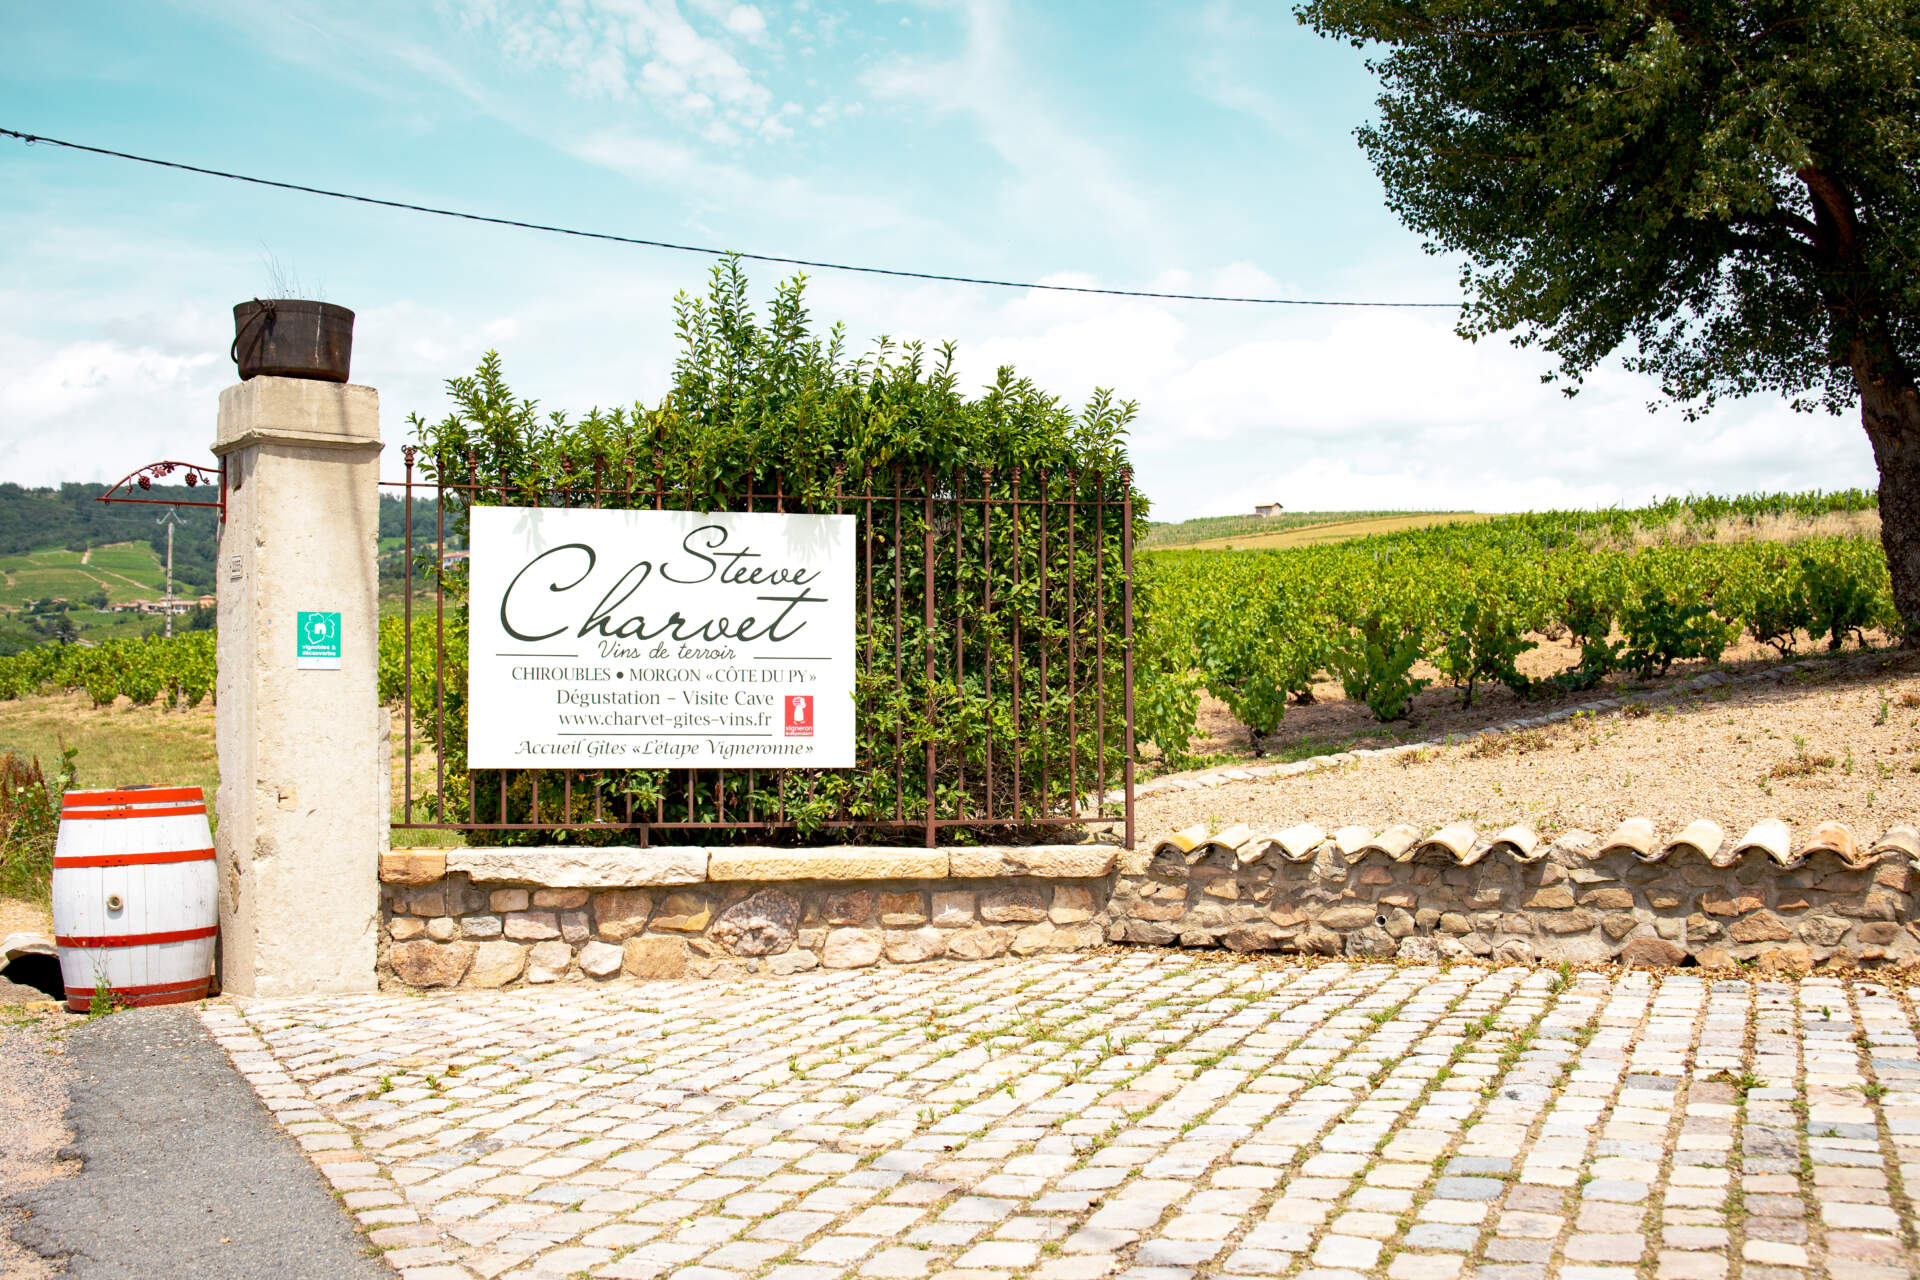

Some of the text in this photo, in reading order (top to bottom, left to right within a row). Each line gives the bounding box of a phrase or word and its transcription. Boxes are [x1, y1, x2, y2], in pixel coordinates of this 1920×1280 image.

[659, 524, 822, 585] Steeve
[499, 542, 829, 643] Charvet
[597, 640, 736, 660] Vins de terroir
[511, 666, 611, 681] CHIROUBLES
[630, 668, 701, 682] MORGON
[761, 669, 784, 683] DU
[557, 689, 660, 708] Dégustation
[682, 690, 729, 706] Visite
[735, 691, 774, 706] Cave
[559, 711, 772, 729] www.charvet-gites-vins.fr
[514, 738, 587, 756] Accueil
